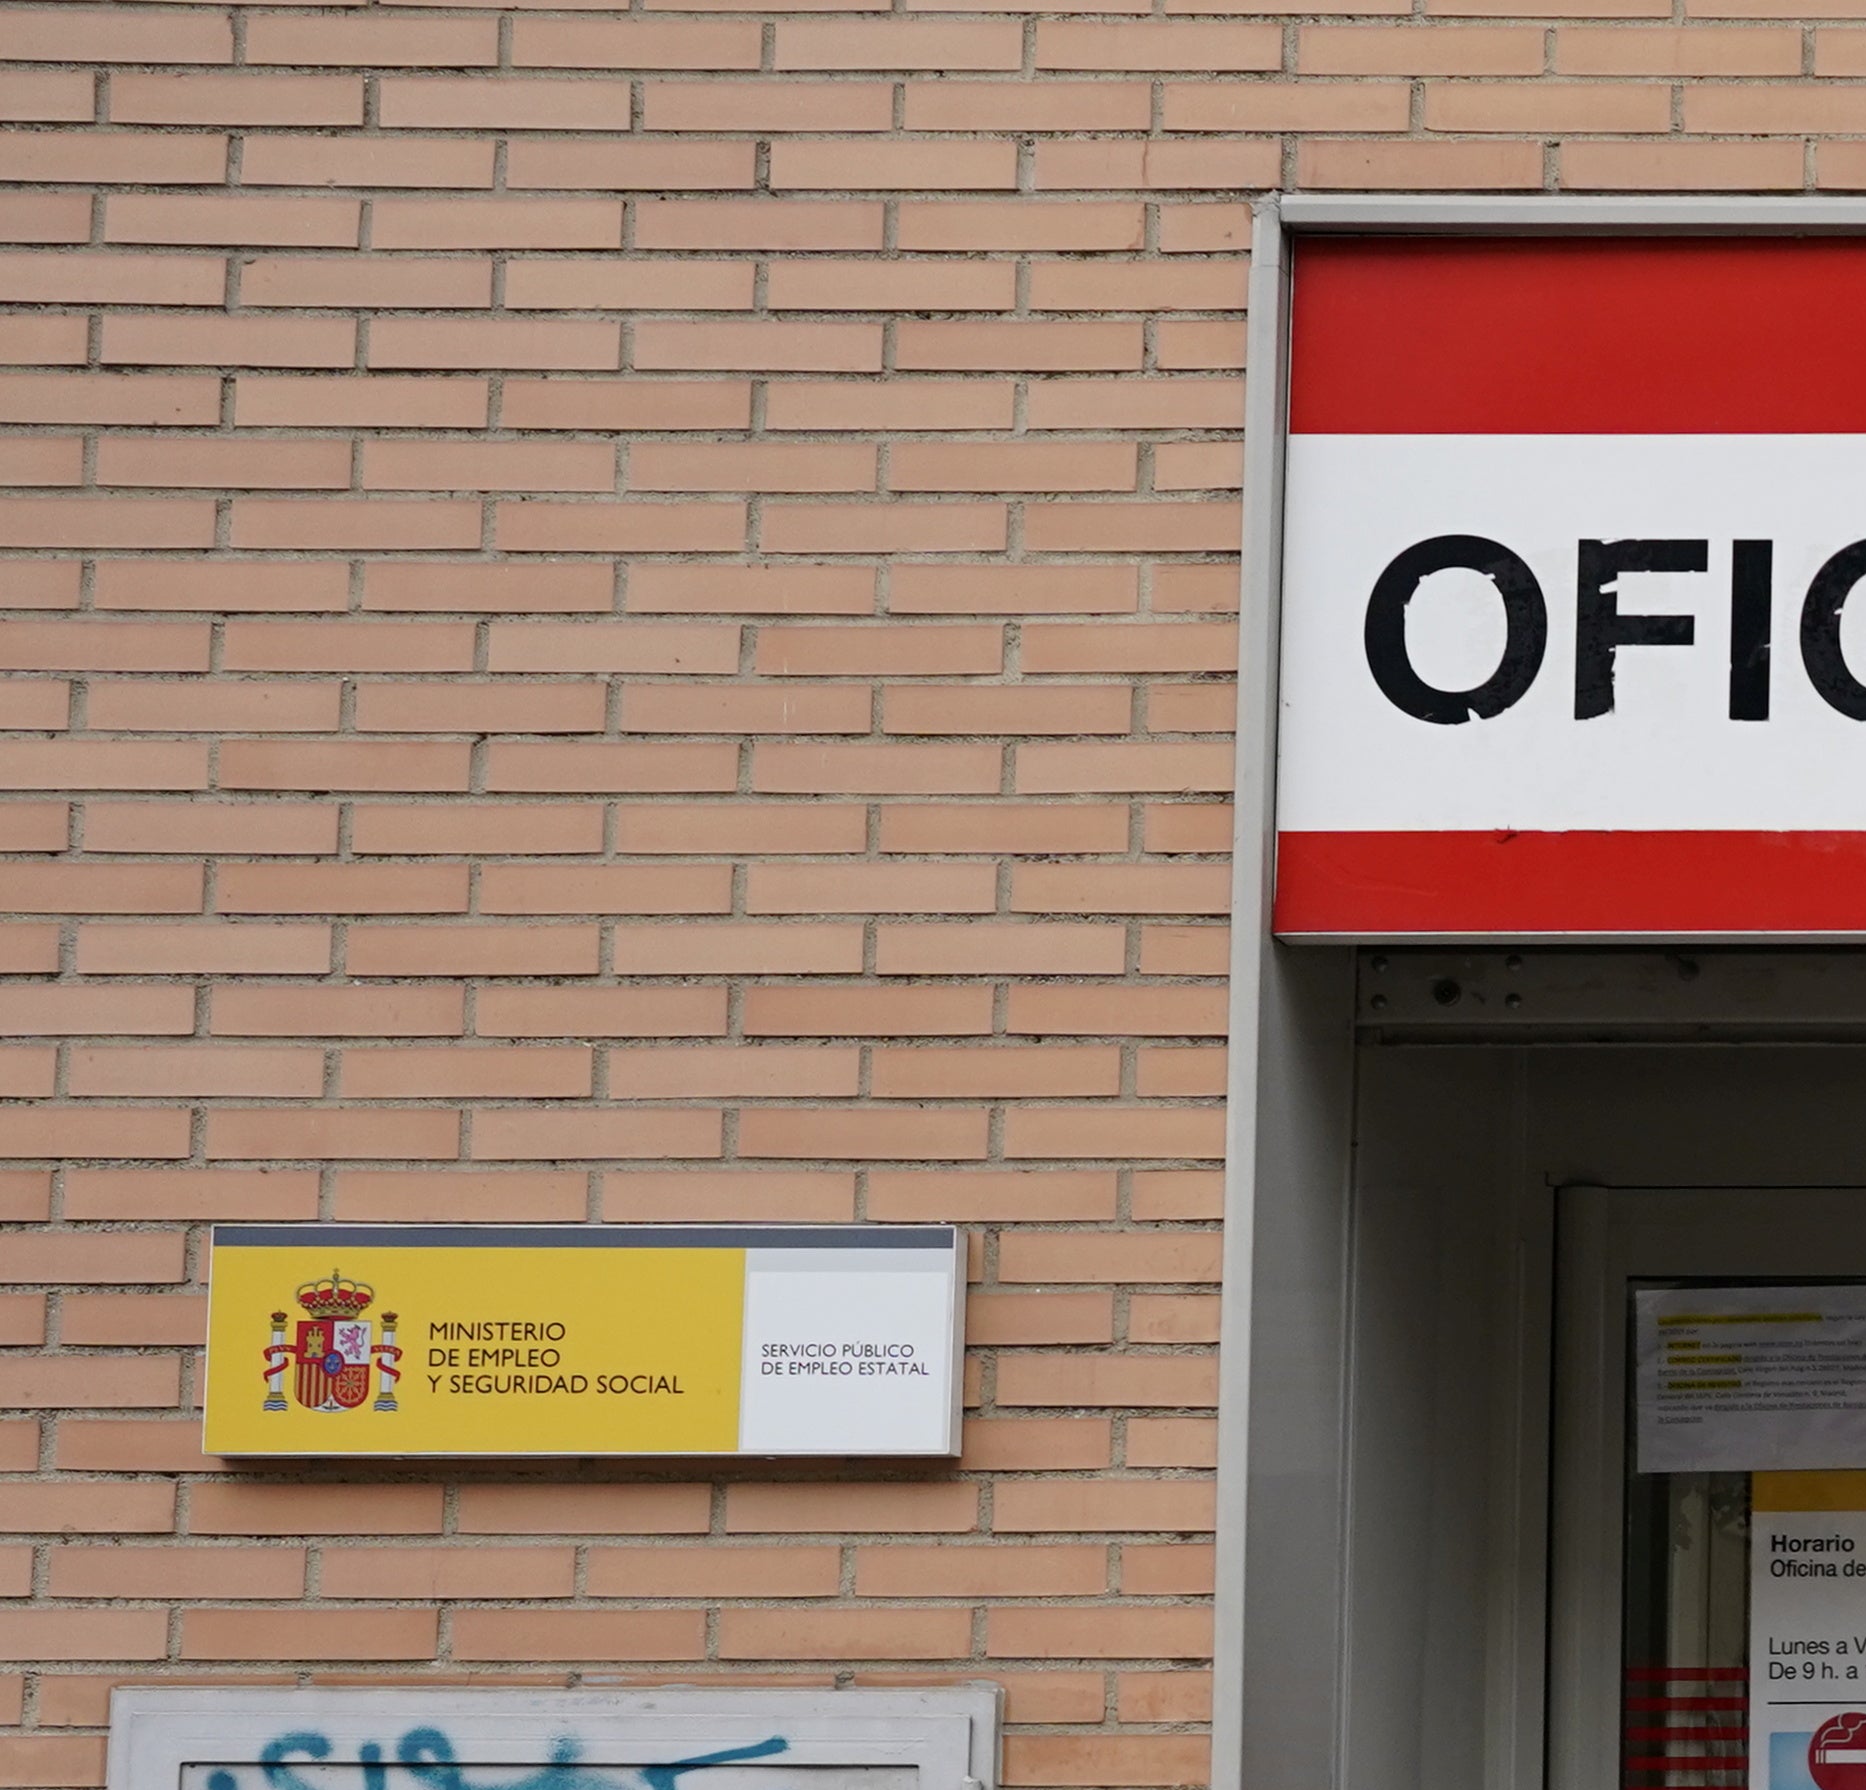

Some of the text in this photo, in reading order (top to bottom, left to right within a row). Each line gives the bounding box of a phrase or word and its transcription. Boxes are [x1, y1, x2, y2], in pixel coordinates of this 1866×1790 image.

[430, 1322, 565, 1341] MINISTERIO
[429, 1349, 560, 1367] DE EMPLEO
[762, 1342, 914, 1357] SERVICIO PÚBLICO
[762, 1362, 929, 1375] DE EMPLEO ESTATAL
[428, 1375, 684, 1394] Y SEGURIDAD SOCIAL
[1771, 1535, 1854, 1552] Horario
[1771, 1559, 1837, 1577] Oficina
[1843, 1559, 1866, 1577] de
[1769, 1637, 1829, 1655] Lunes
[1836, 1641, 1848, 1654] a
[1769, 1662, 1796, 1679] De
[1803, 1662, 1815, 1679] 9
[1822, 1662, 1838, 1679] h.
[1846, 1666, 1858, 1679] a
